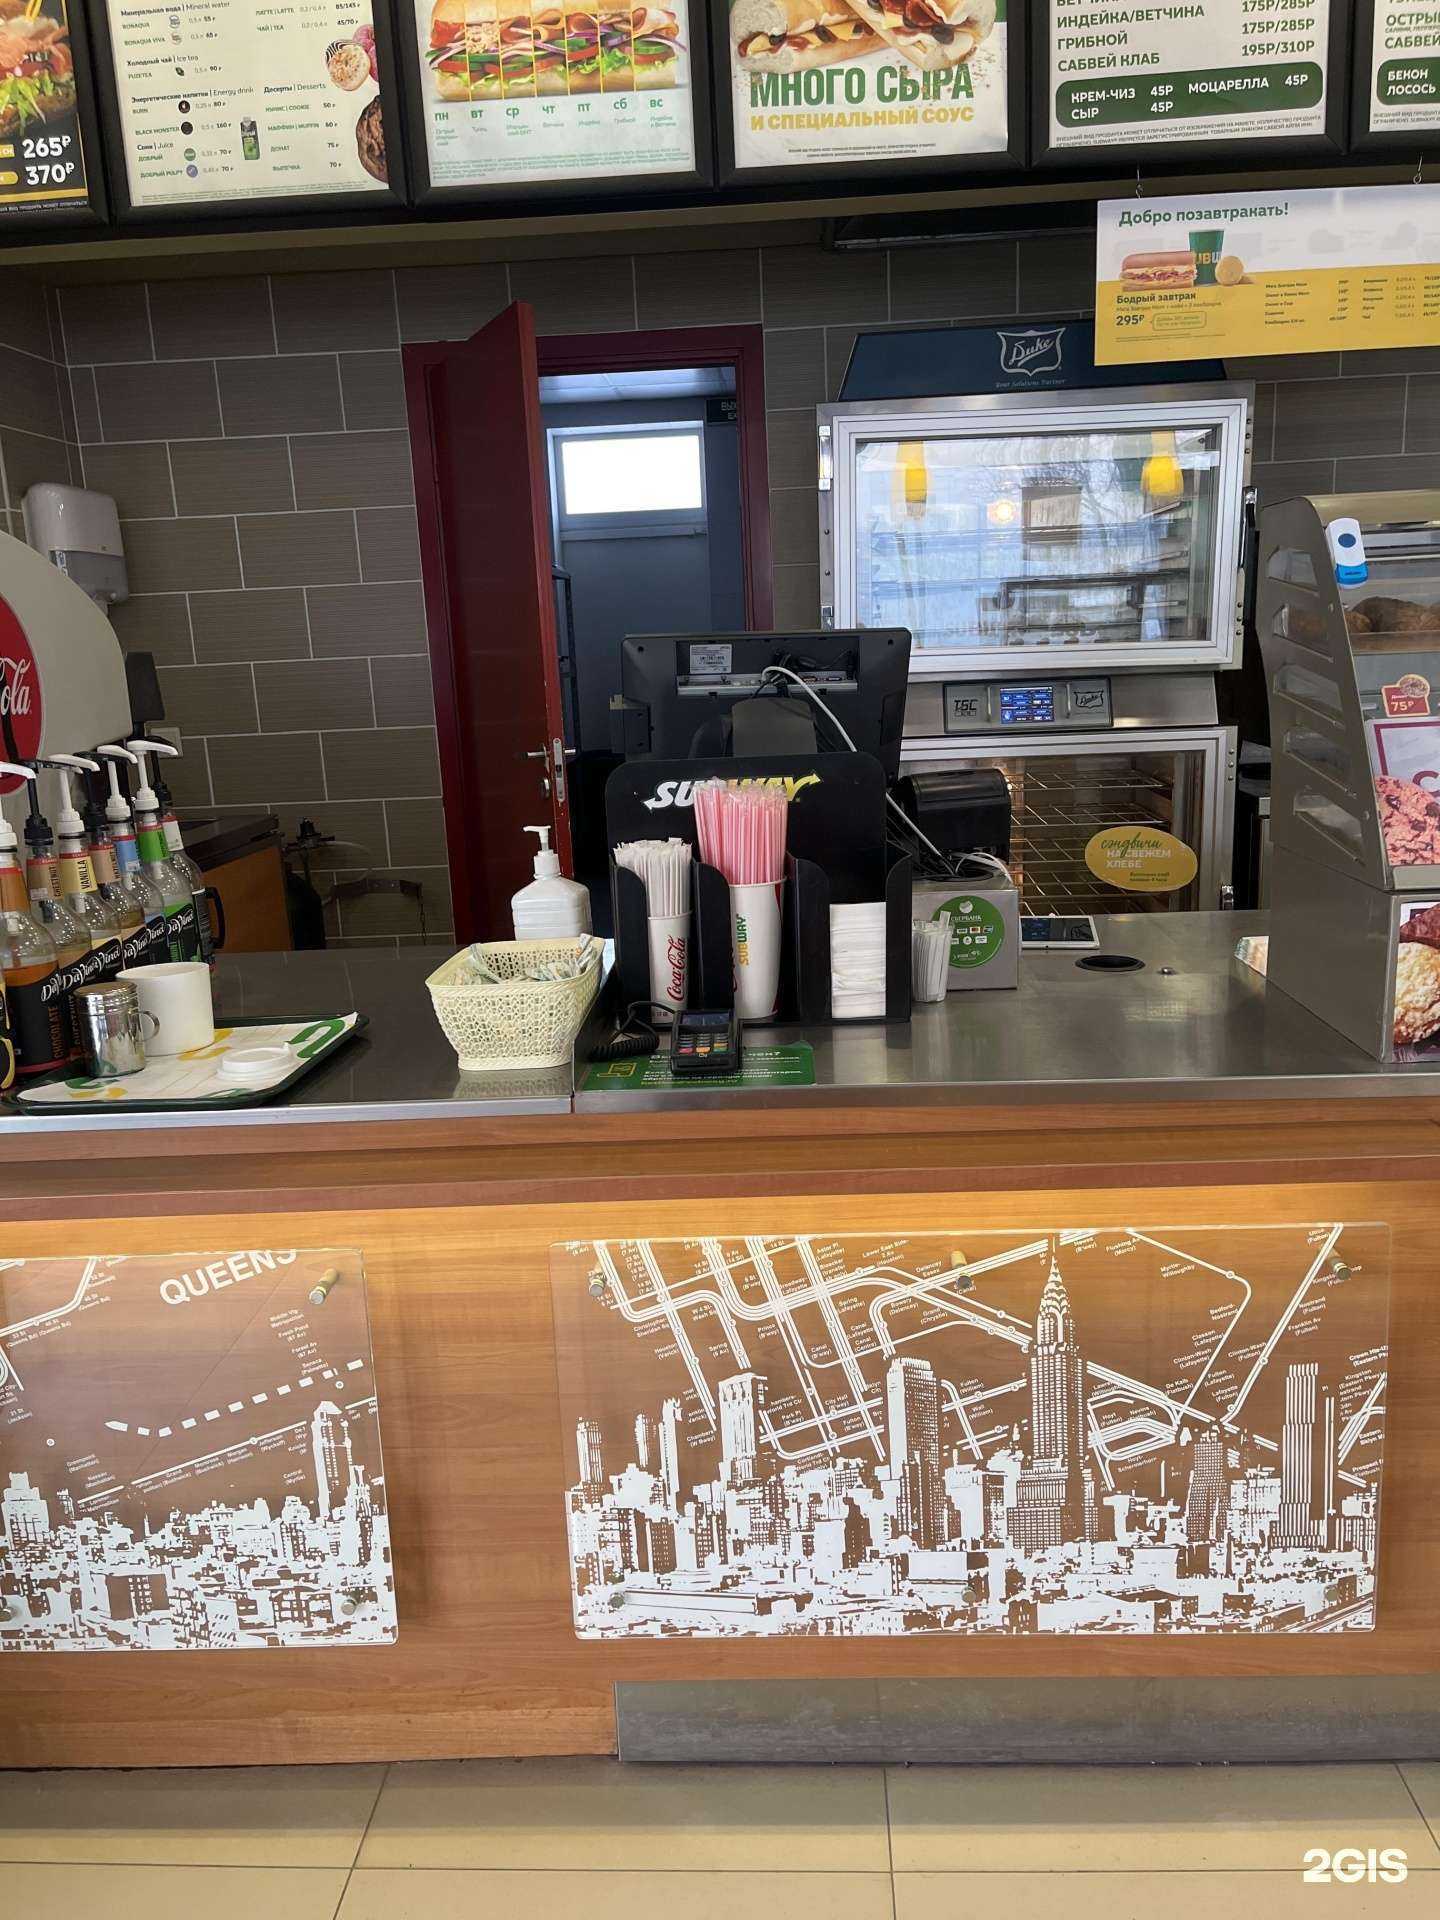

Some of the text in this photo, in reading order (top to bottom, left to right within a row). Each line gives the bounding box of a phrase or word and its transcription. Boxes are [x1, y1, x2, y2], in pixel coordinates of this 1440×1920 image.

[1056, 5, 1204, 28] ИНДЕЙКА/ВЕТЧИНА
[1057, 30, 1128, 50] ГРИБНОЙ
[1057, 52, 1160, 72] САБВЕЙ КЛАБ
[1388, 69, 1429, 81] БЕКОН
[750, 63, 974, 108] МНОГО СЫРА
[1071, 86, 1136, 104] КРЕМ-ЧИЗ
[1188, 76, 1270, 95] МОЦАРЕЛЛА
[1386, 83, 1436, 96] ЛОСОСЬ
[542, 105, 555, 114] чт
[578, 104, 591, 112] пт
[614, 98, 627, 110] сб
[650, 99, 663, 108] вс
[435, 113, 448, 121] пн
[471, 110, 483, 118] вт
[506, 108, 519, 119] ср
[750, 106, 975, 132] И СПЕЦИАЛЬНЫЙ СОУС
[1071, 106, 1099, 121] СЫР
[1118, 202, 1289, 227] Добро позавтракать!
[1116, 292, 1196, 304] Бодрый завтрак
[1100, 832, 1162, 858] сэндвичи
[1124, 849, 1171, 858] СВЕЖЕМ
[1106, 860, 1143, 868] ХЛЕБЕ
[77, 859, 91, 890] VANILLA
[736, 913, 748, 966] SUBWAY
[48, 1005, 64, 1058] CHOCOLATE
